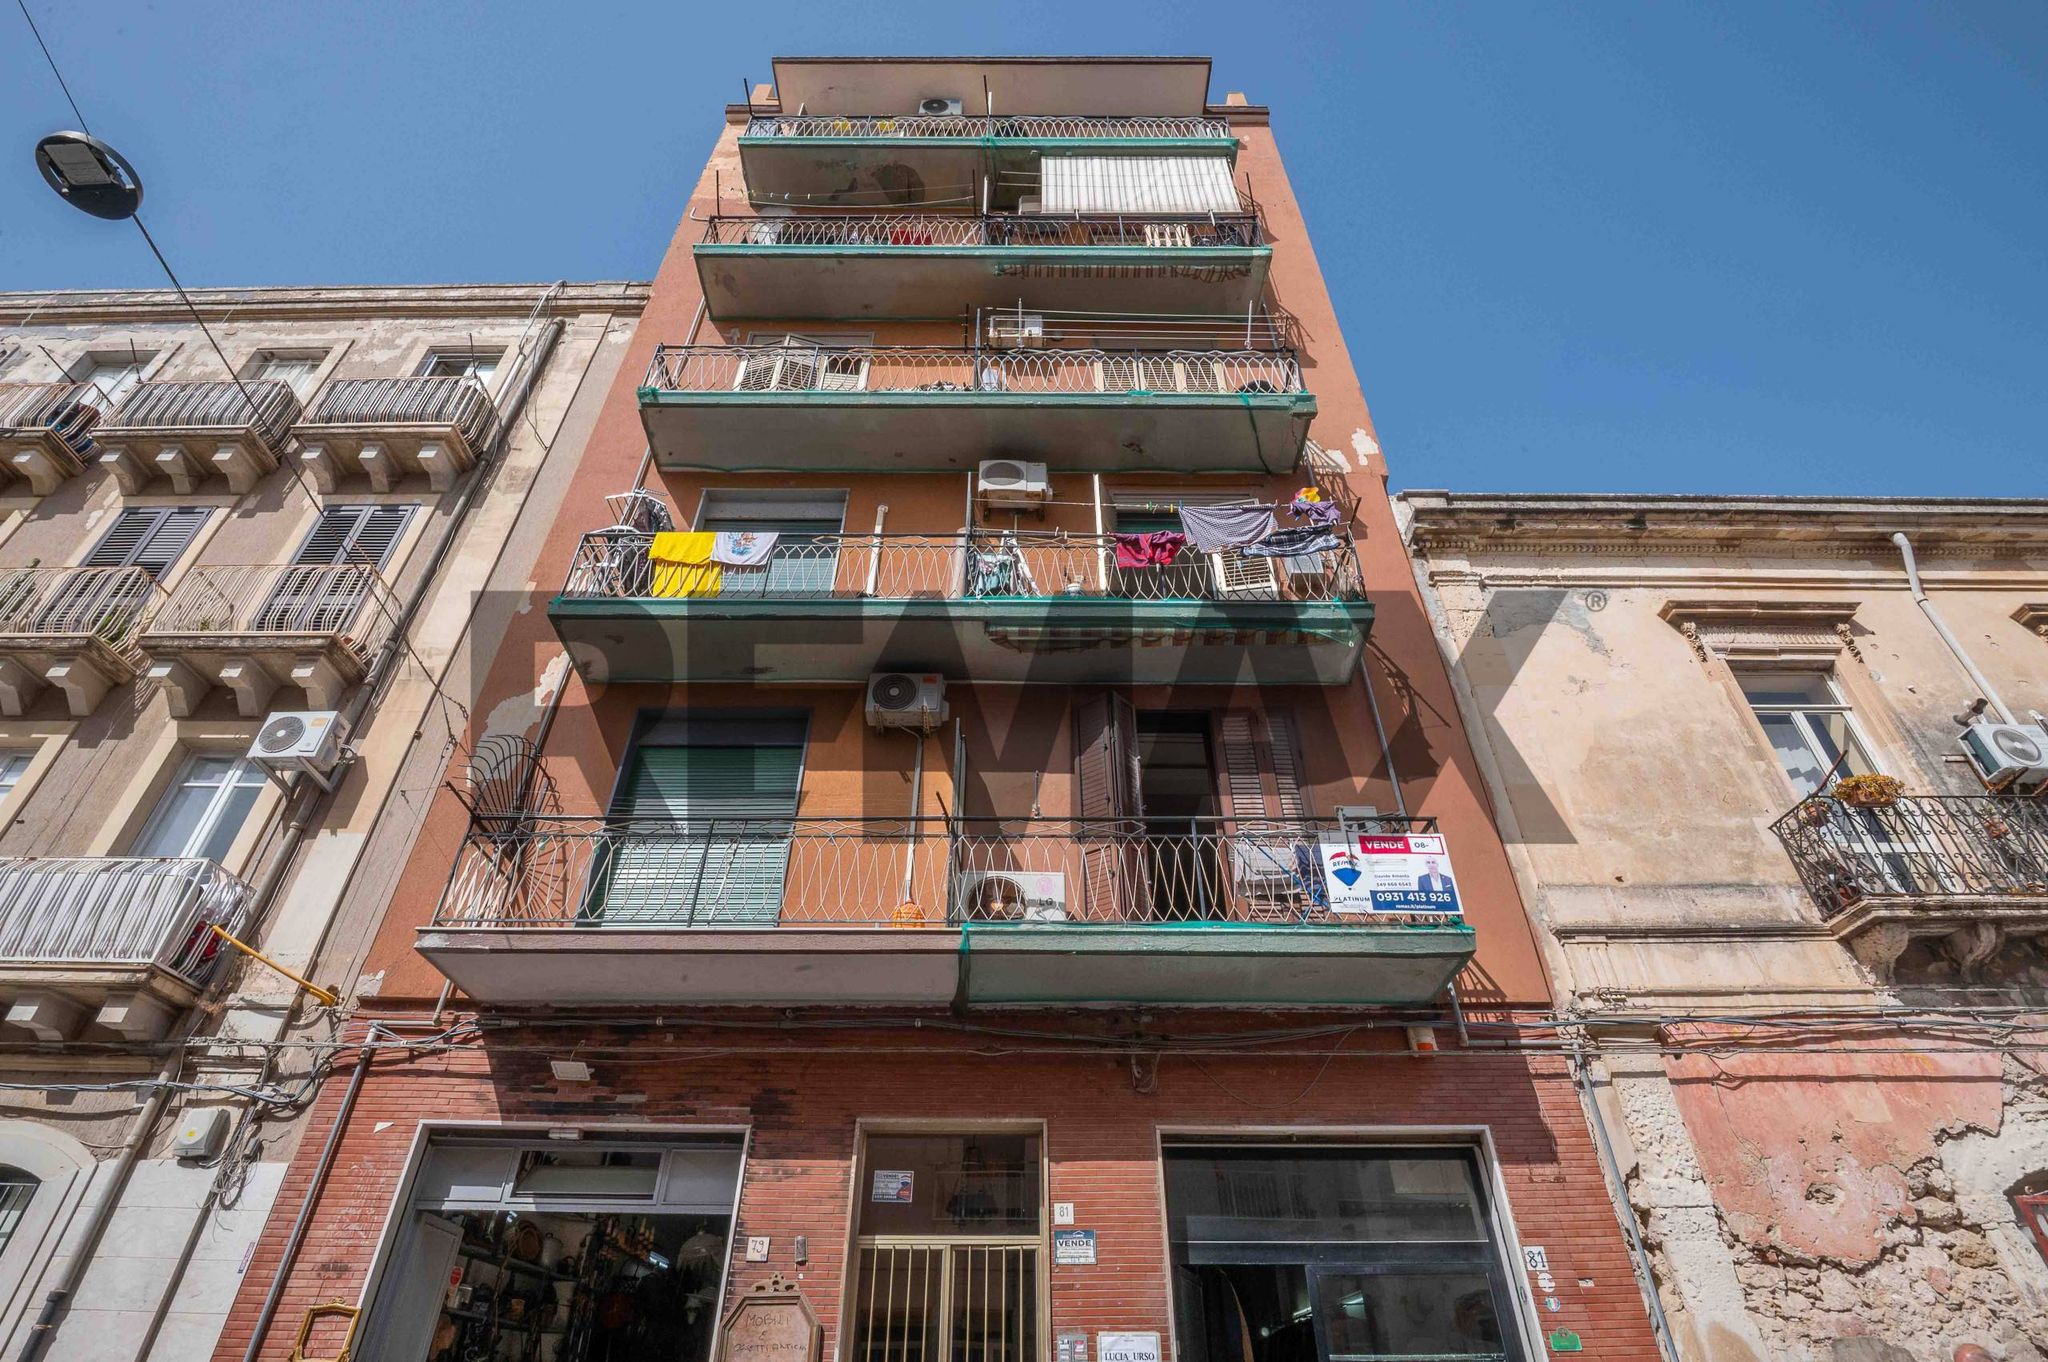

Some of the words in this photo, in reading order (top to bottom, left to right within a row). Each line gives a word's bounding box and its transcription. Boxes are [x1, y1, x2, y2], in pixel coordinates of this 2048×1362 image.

[1365, 841, 1405, 849] VENDE
[1376, 892, 1404, 902] 0931
[1407, 892, 1427, 902] 413
[1429, 892, 1452, 902] 926
[1059, 1206, 1069, 1217] 81
[752, 1239, 764, 1254] 79
[1058, 1239, 1092, 1247] VENDE
[1527, 1250, 1546, 1268] 81
[1105, 1352, 1129, 1361] LUCIA
[1132, 1352, 1155, 1361] URSO
